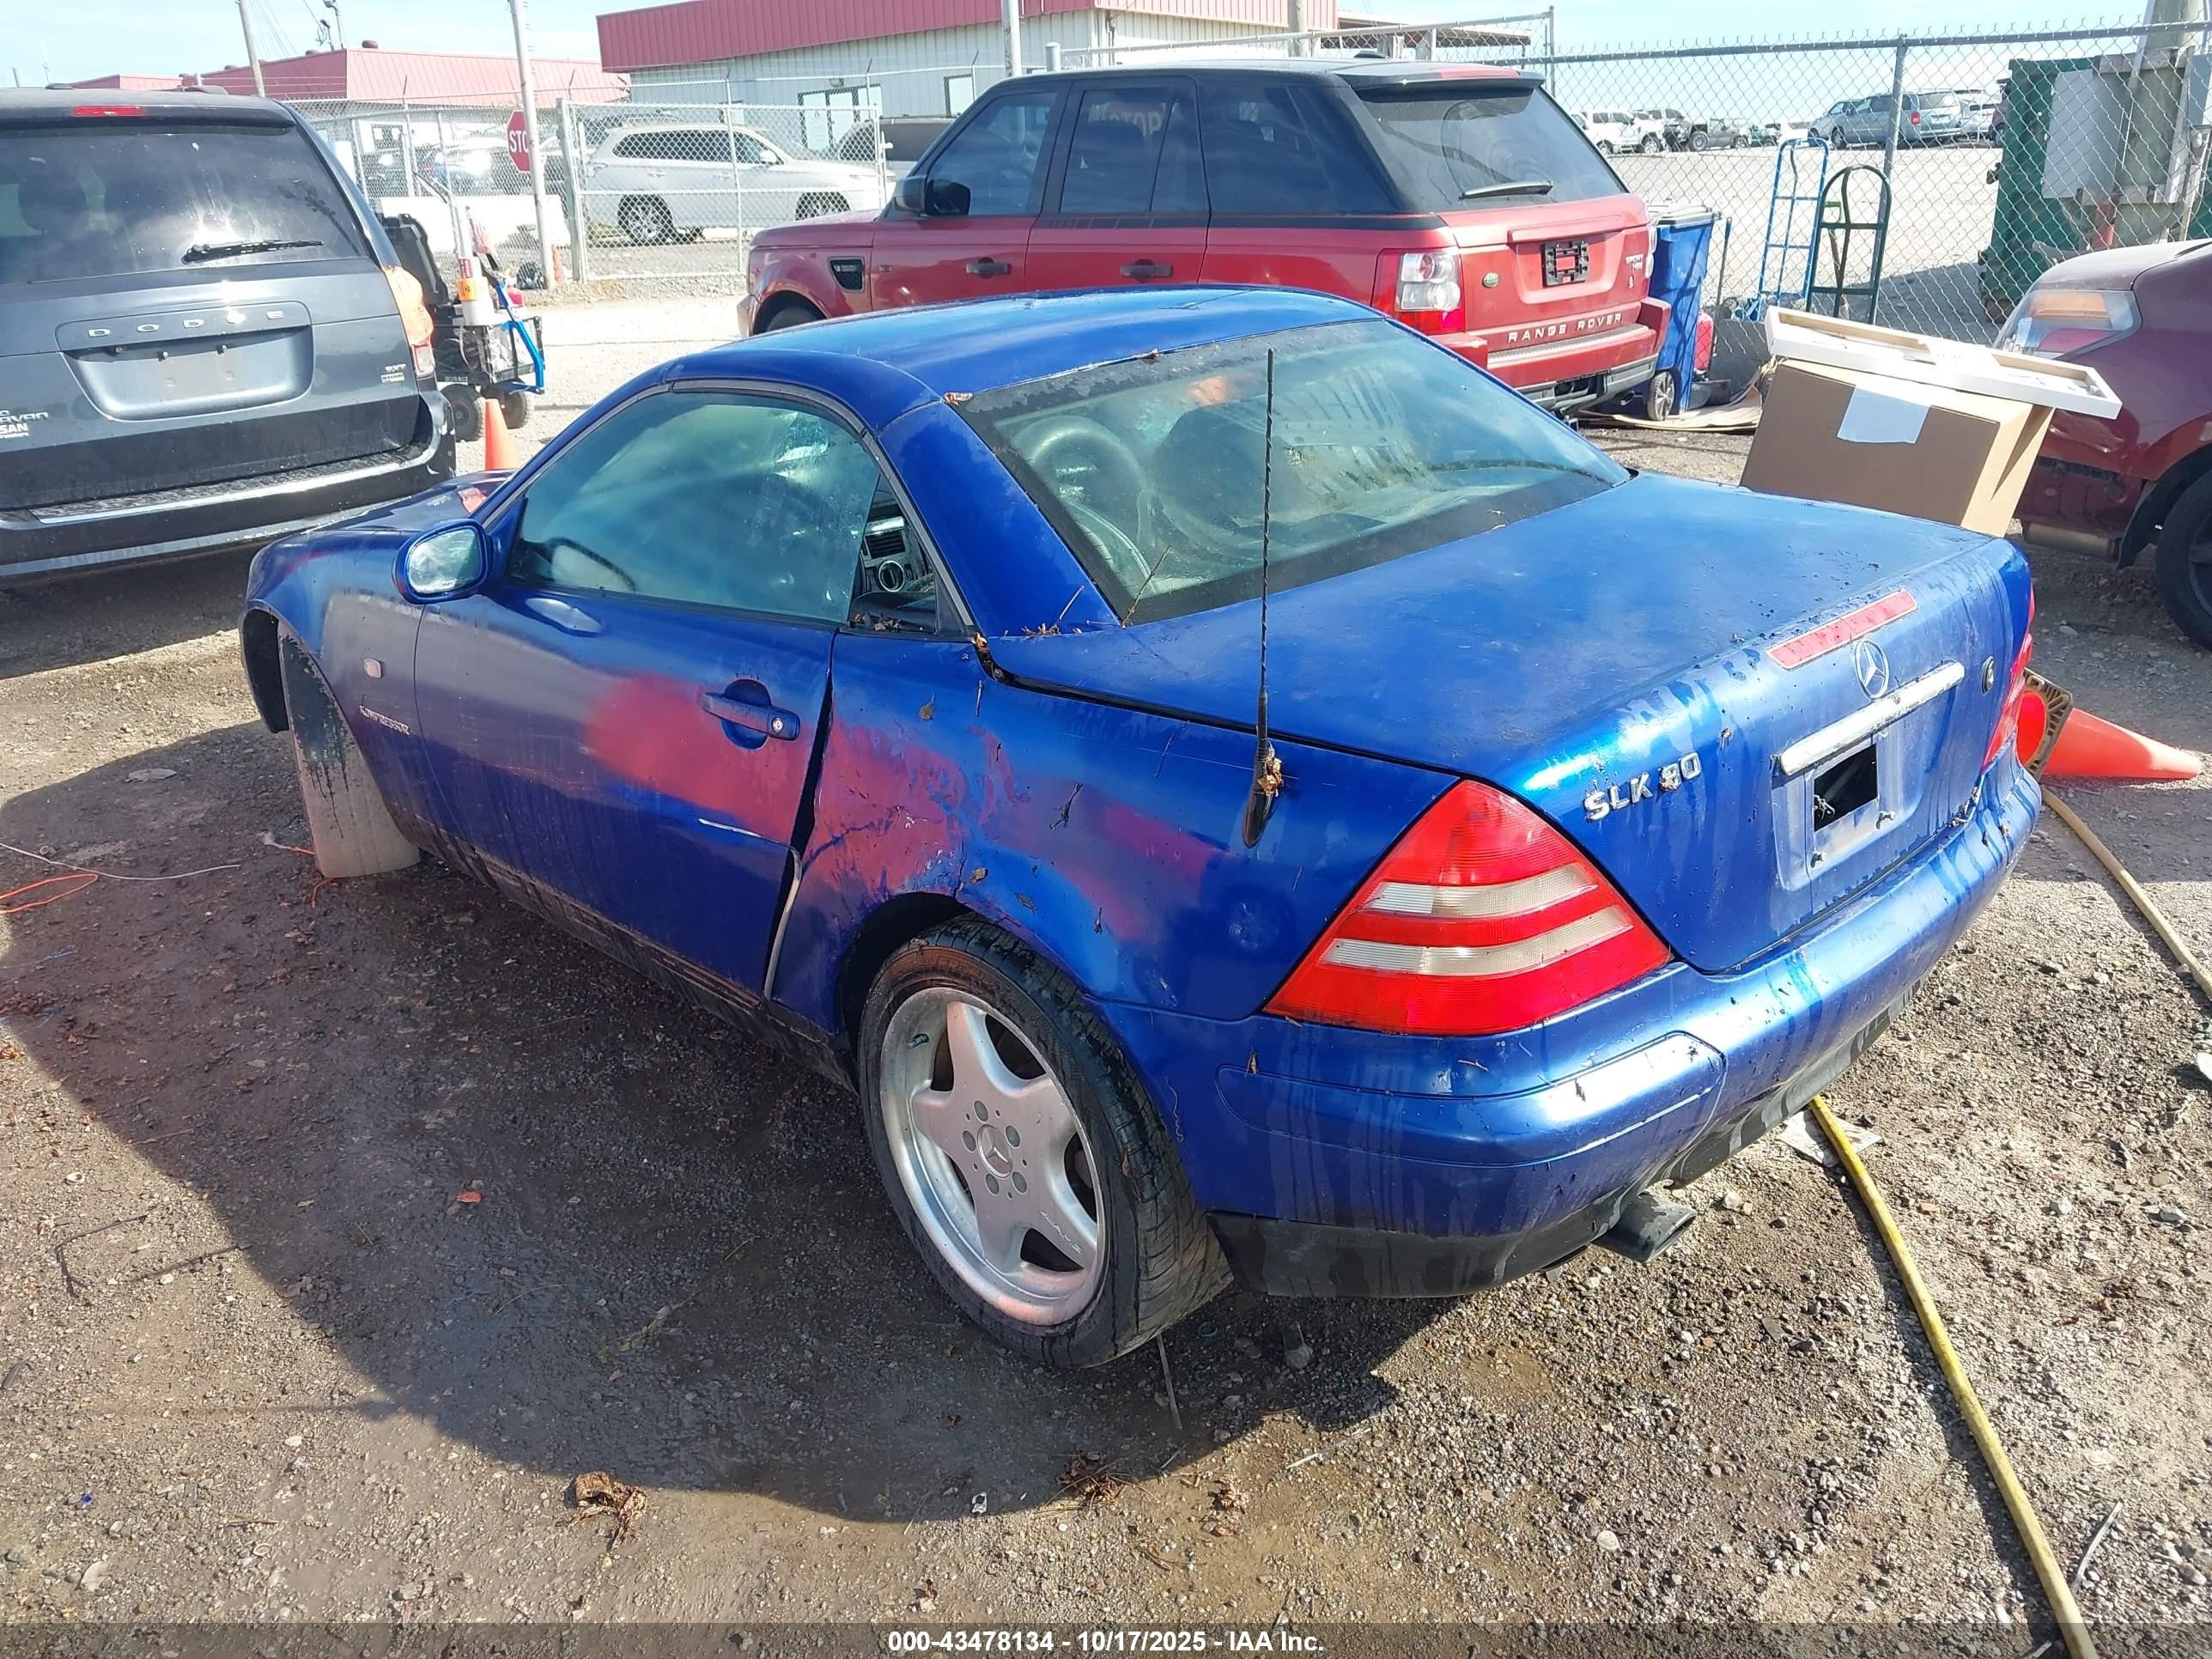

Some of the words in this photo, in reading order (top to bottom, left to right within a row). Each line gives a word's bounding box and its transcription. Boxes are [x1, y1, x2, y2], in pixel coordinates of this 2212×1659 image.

[509, 130, 528, 153] STO
[1508, 323, 1567, 343] RANGE
[1577, 313, 1622, 331] ROVER
[1583, 771, 1654, 821] SLK
